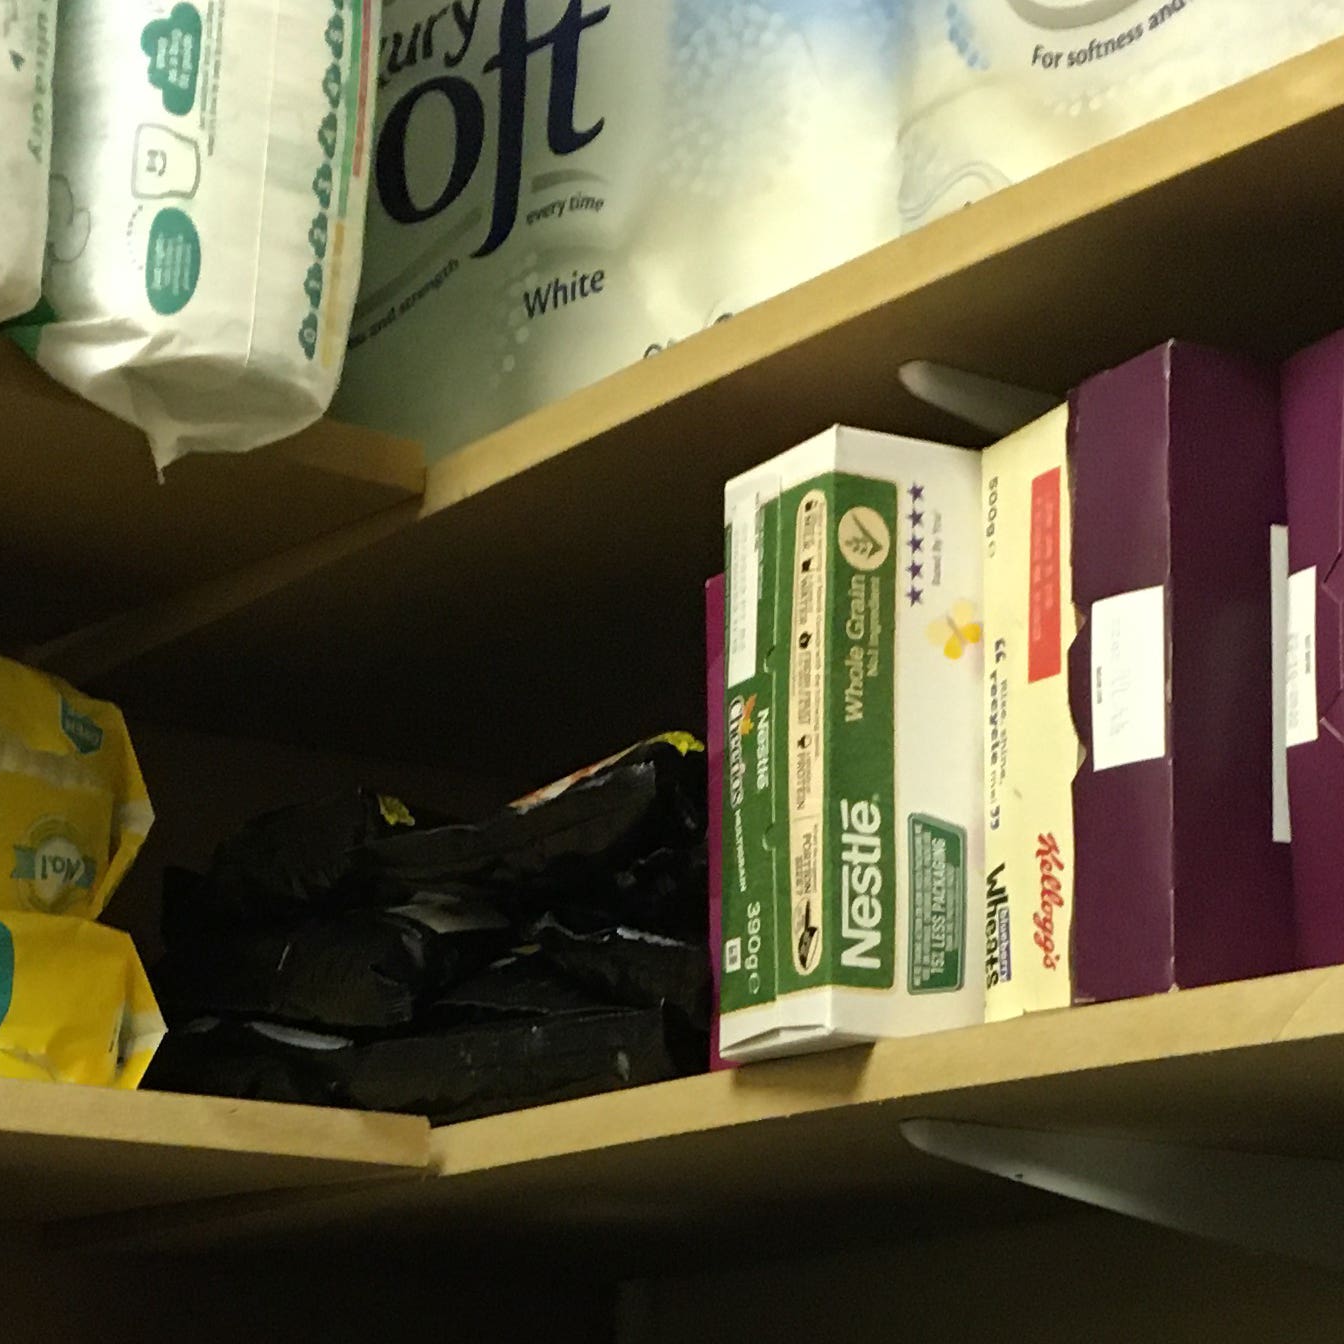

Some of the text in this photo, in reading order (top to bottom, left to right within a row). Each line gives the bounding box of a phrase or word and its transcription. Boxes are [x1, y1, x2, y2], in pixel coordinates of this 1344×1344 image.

[1031, 23, 1144, 69] For softness
[526, 191, 604, 226] every time
[523, 269, 605, 319] White
[845, 574, 866, 722] Whole Grain
[839, 798, 883, 970] Nestlé
[928, 837, 948, 914] PACKAGING
[1032, 832, 1065, 970] Kellogg's
[745, 901, 762, 970] 390g
[929, 913, 947, 949] LESS
